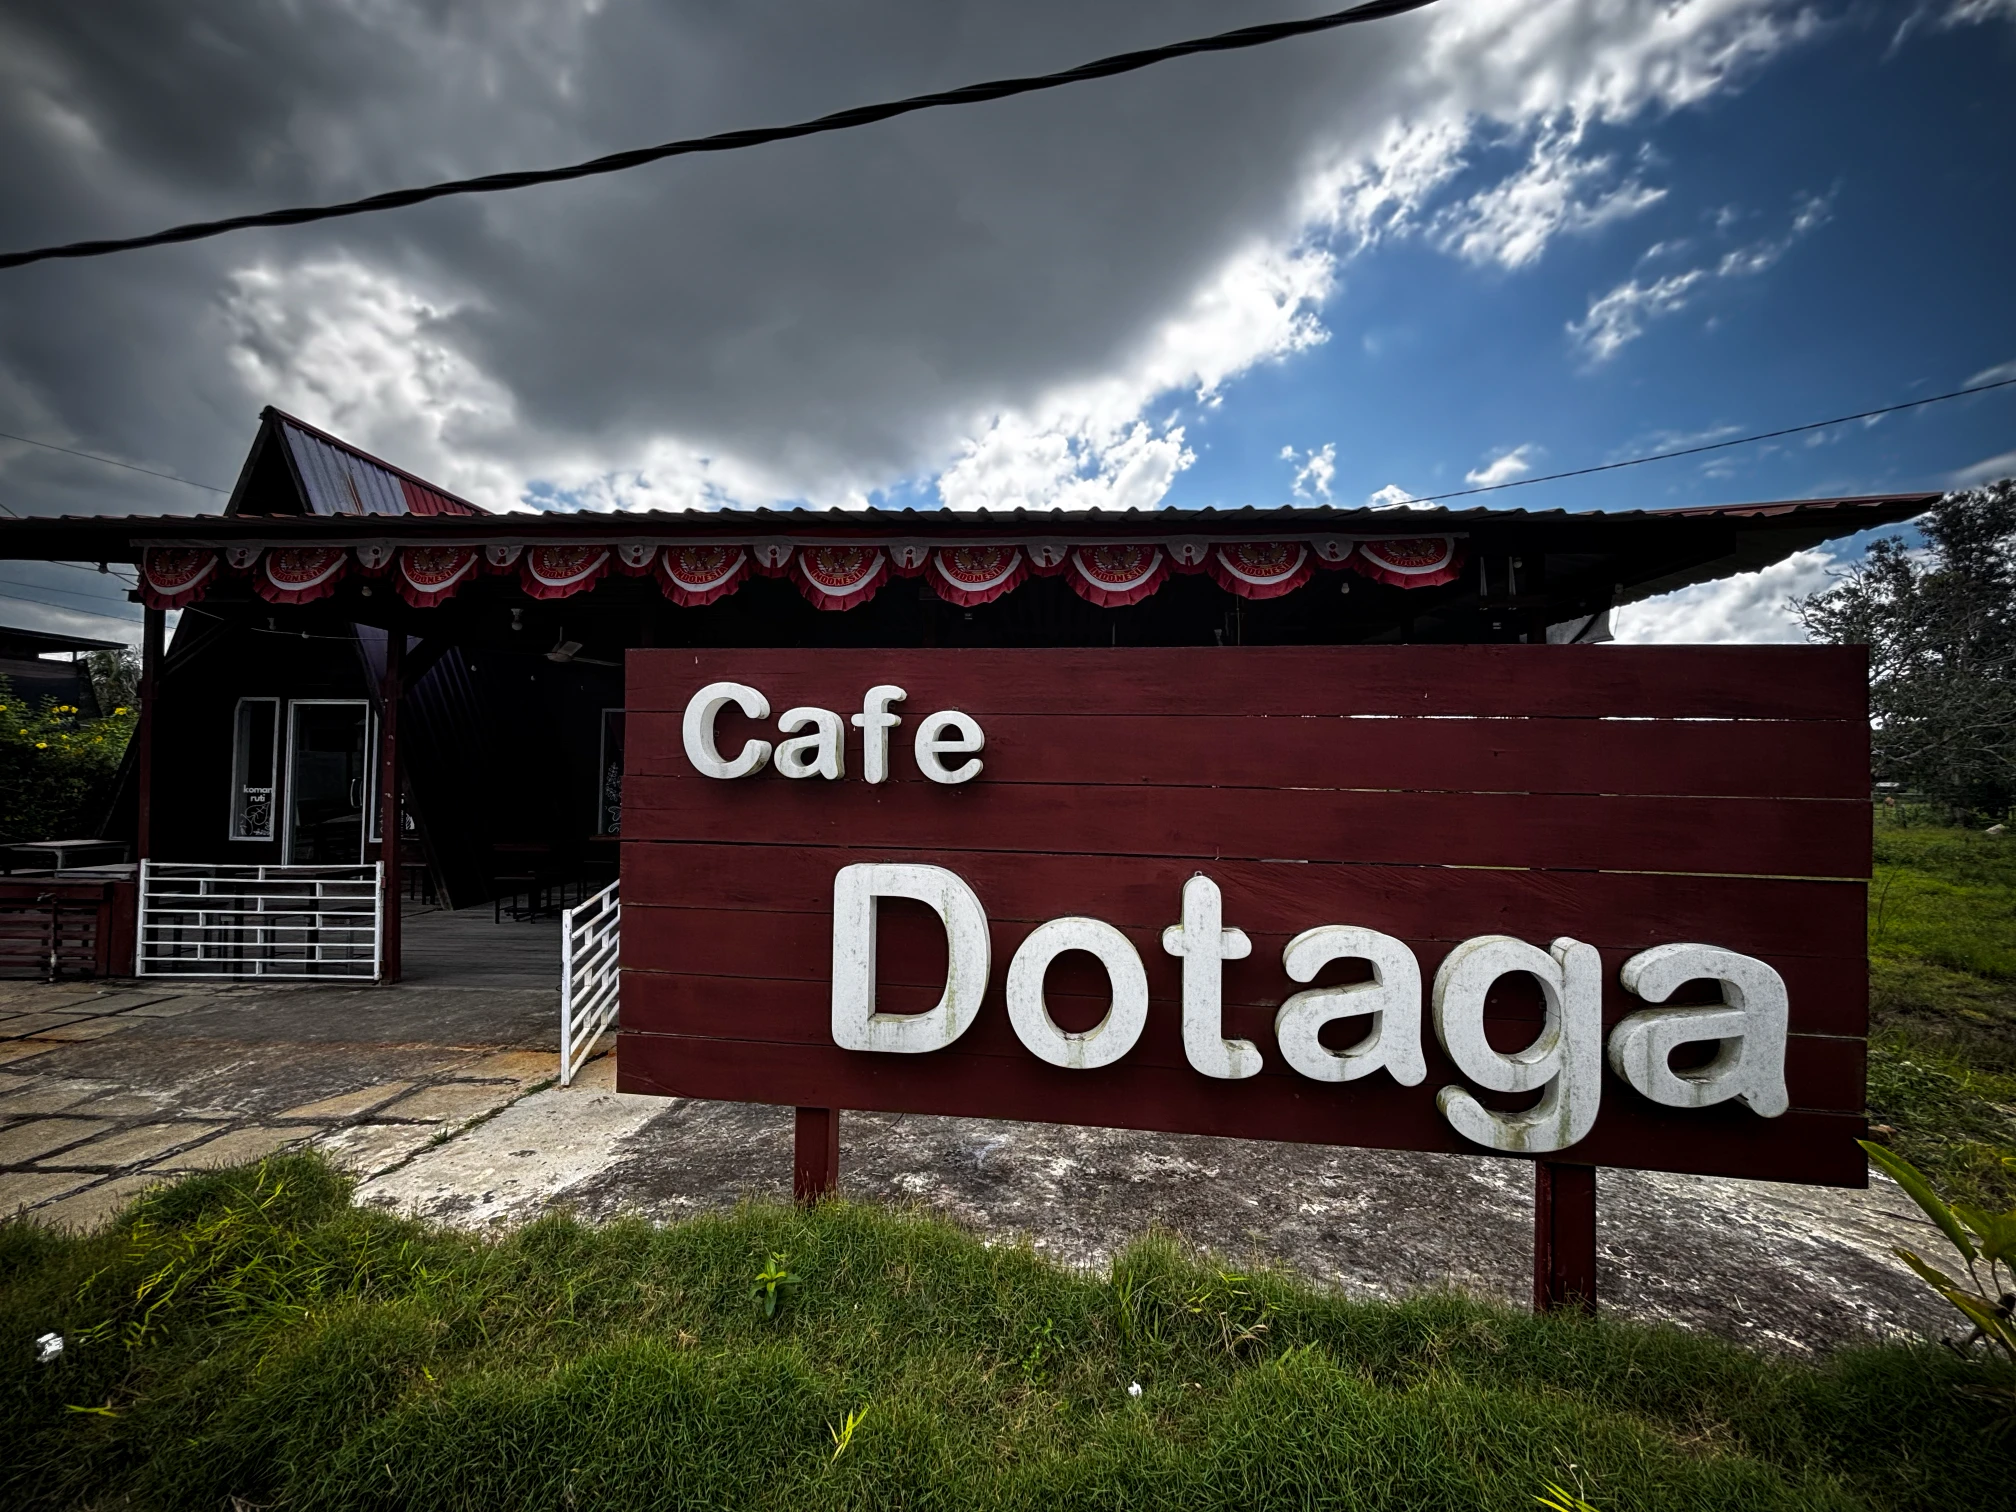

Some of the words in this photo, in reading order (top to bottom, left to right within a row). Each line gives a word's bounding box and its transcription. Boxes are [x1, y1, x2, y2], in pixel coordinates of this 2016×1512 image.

[273, 567, 325, 582] INDONESIA
[407, 567, 458, 584] INDONESIA
[535, 563, 590, 579] INDONESIA
[673, 567, 728, 584] INDONESIA
[810, 568, 867, 586] INDONESIA
[949, 564, 1007, 582] INDONESIA
[1089, 564, 1148, 582] INDONESIA
[1235, 560, 1295, 577] INDONESIA
[148, 570, 197, 586] INDONESIA
[682, 681, 985, 784] Cafe
[832, 862, 1790, 1154] Dotaga
